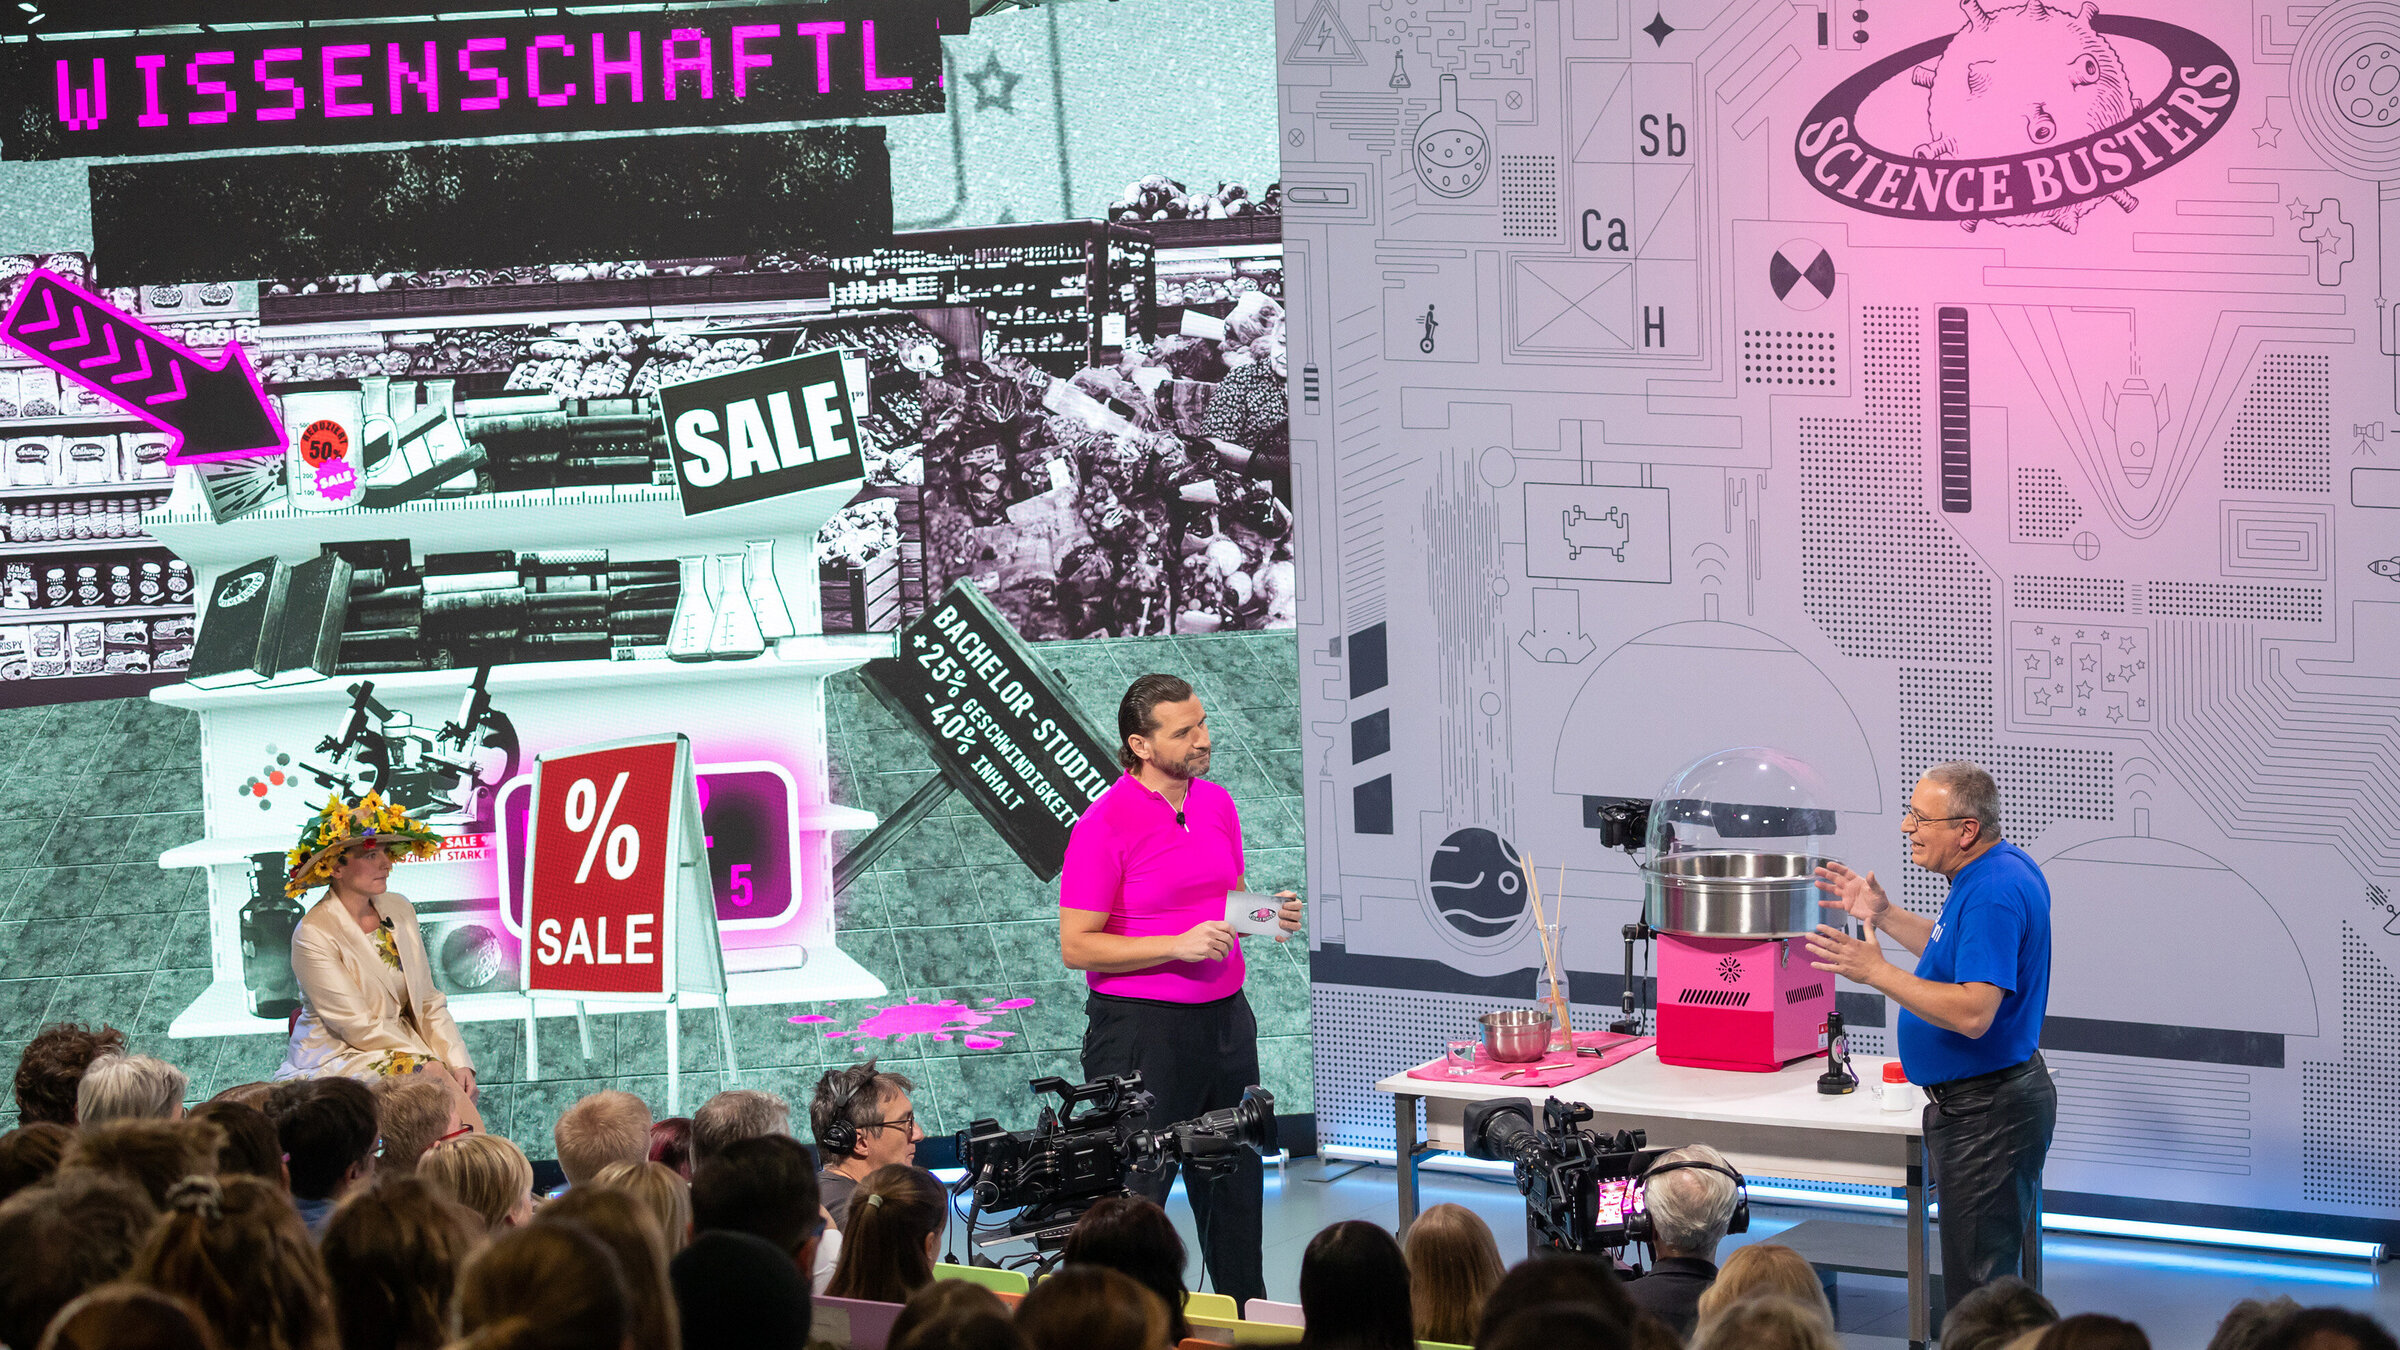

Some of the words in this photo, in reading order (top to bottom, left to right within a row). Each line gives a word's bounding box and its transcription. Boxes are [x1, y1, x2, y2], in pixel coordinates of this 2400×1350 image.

[56, 17, 943, 131] WISSENSCHAFTL
[1639, 113, 1687, 157] Sb
[1798, 116, 2013, 213] SCIENCE
[2021, 64, 2233, 203] BUSTERS
[1581, 208, 1629, 252] Ca
[1642, 305, 1666, 348] H
[302, 421, 348, 444] REDUZIERT
[673, 380, 852, 488] SALE
[319, 470, 353, 490] SALE
[932, 605, 1112, 803] BACHELOR-STUDIU
[912, 634, 968, 698] +25%
[962, 697, 1081, 828] GESCHWINDIGKEIT
[924, 692, 977, 755] -40%
[970, 754, 1026, 812] INHALT
[445, 836, 477, 848] SALE
[447, 849, 482, 861] STARK
[730, 864, 754, 907] 5
[537, 913, 654, 966] SALE
